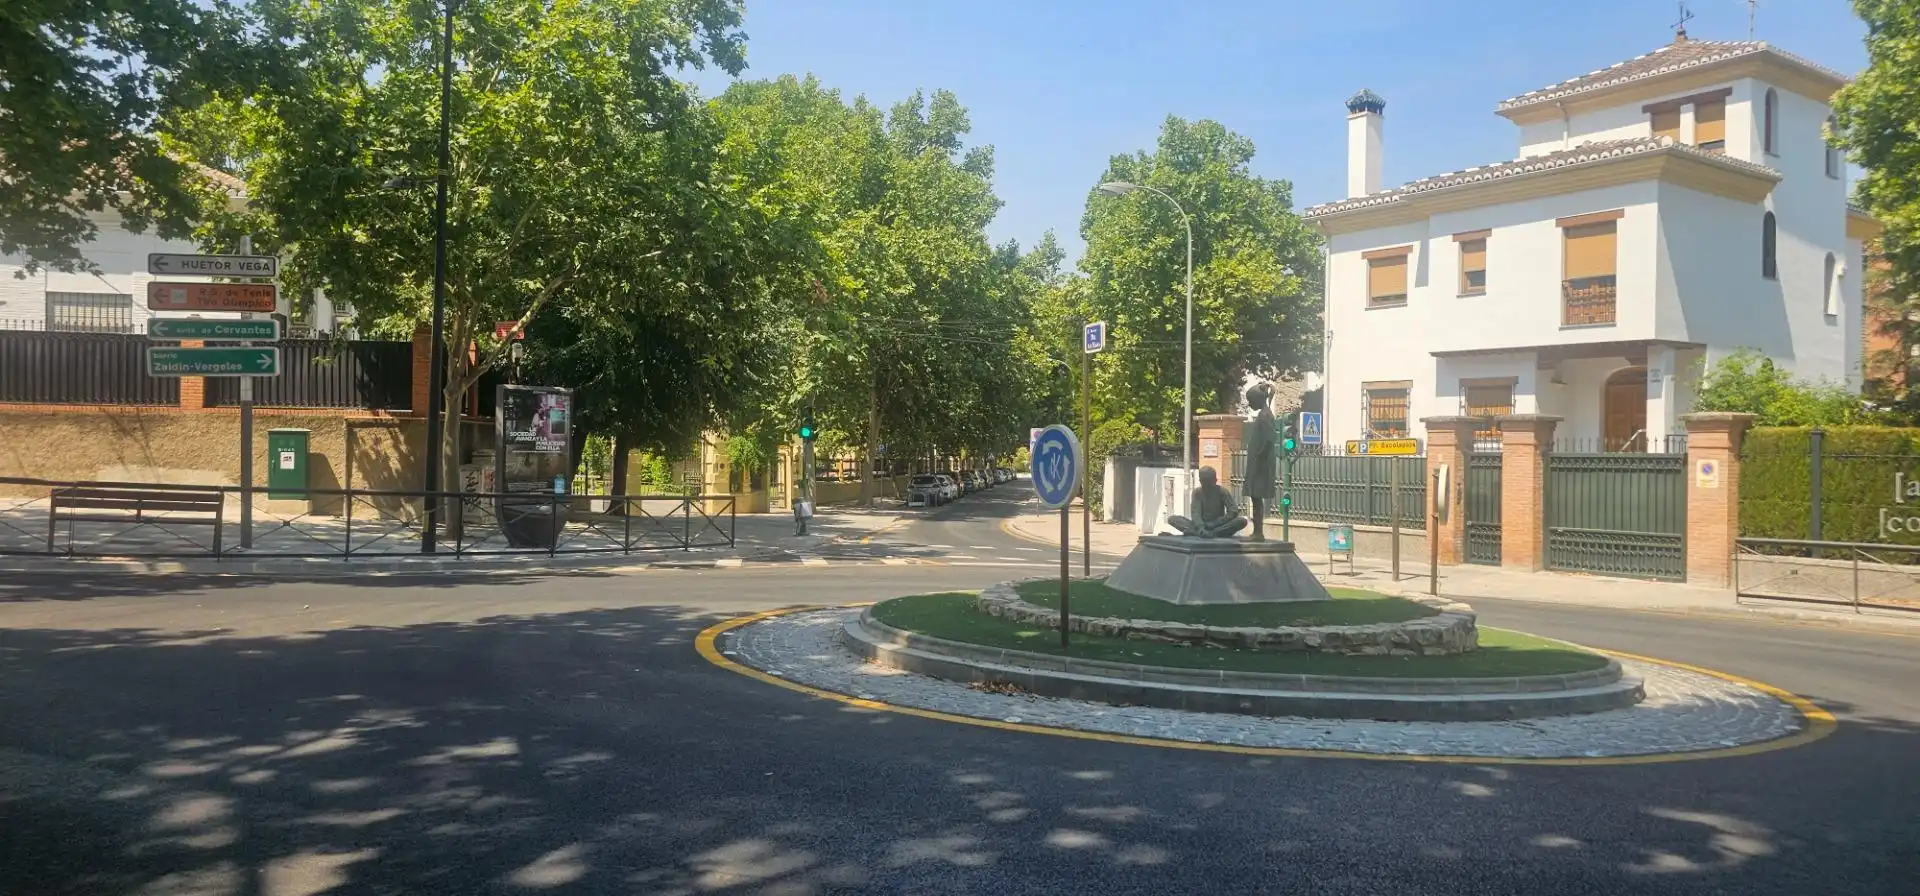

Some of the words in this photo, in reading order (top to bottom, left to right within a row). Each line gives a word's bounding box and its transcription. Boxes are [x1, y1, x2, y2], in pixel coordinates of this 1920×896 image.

[181, 260, 232, 270] HUETOR
[238, 262, 271, 272] VEGA
[214, 325, 272, 334] Cervantes
